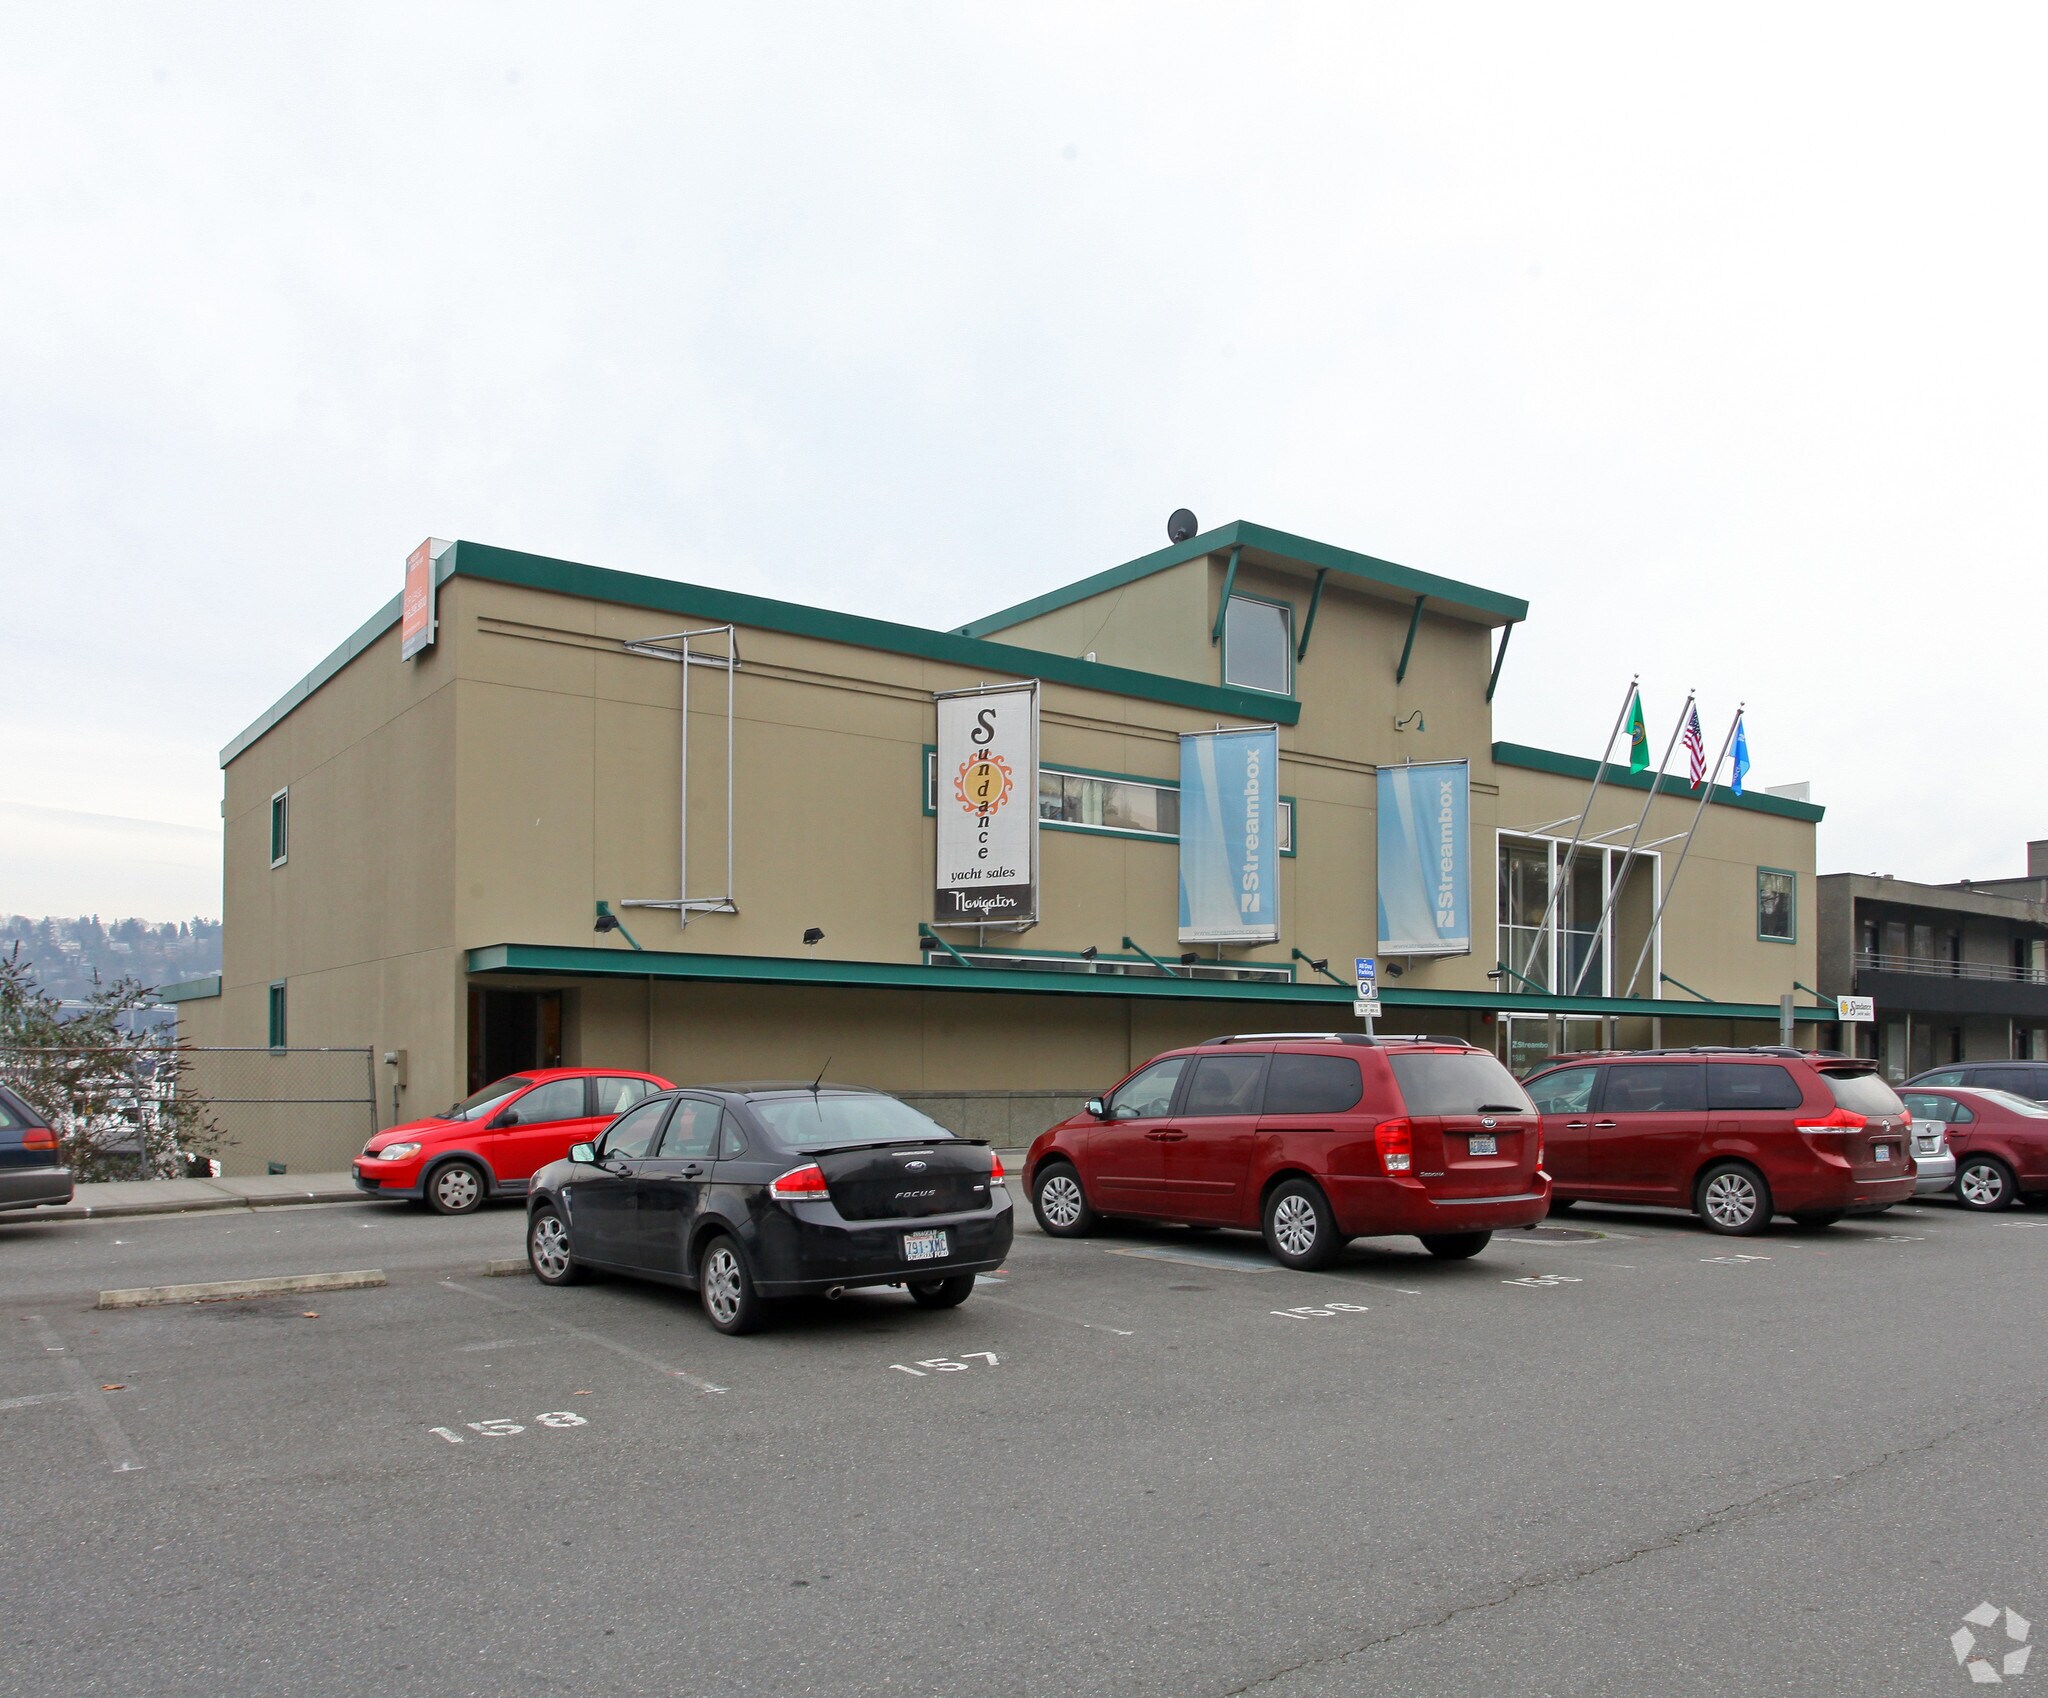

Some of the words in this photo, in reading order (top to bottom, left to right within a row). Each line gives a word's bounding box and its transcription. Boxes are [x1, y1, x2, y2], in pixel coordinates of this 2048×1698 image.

[970, 708, 997, 860] Sundance
[1242, 749, 1261, 893] Streambox
[1438, 780, 1454, 909] Streambox
[951, 868, 982, 883] yacht
[986, 866, 1016, 879] sales
[948, 891, 1018, 915] Navigator
[1358, 969, 1374, 977] Parking
[1517, 1041, 1549, 1049] Streambo
[895, 1190, 936, 1200] FOCUS
[1270, 1303, 1369, 1320] 156
[889, 1352, 1000, 1376] 157
[428, 1411, 588, 1443] 158
